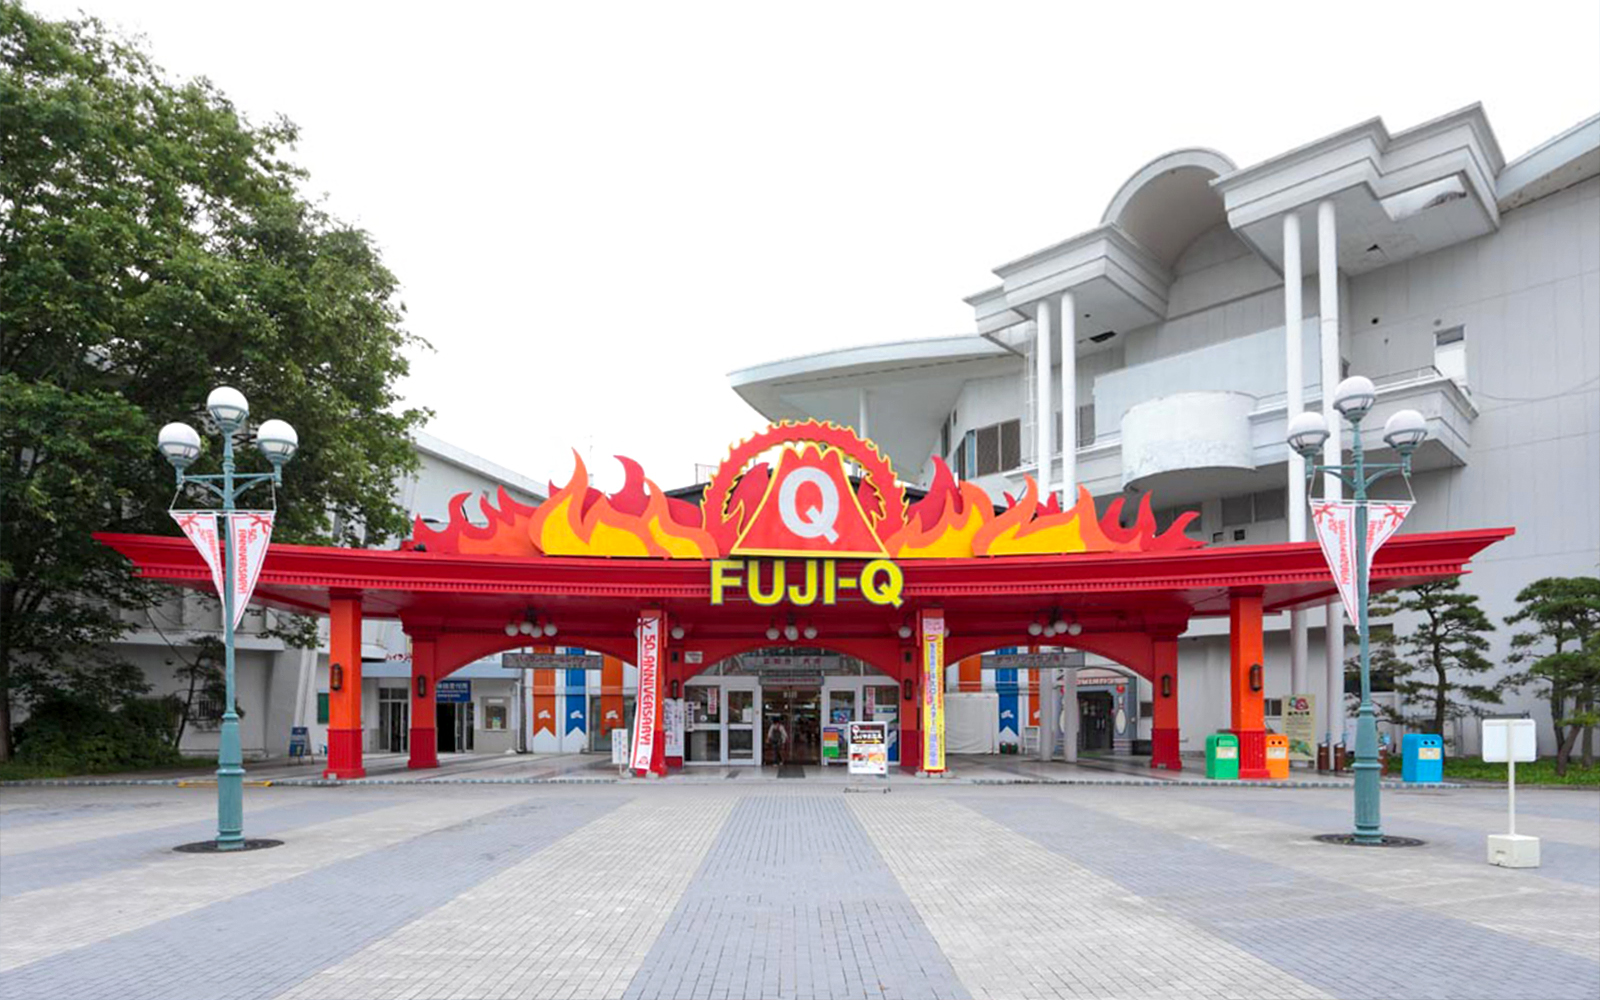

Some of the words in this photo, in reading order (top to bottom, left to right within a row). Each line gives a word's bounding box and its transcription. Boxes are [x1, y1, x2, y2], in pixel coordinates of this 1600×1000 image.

[778, 466, 839, 544] Q
[710, 559, 904, 608] FUJI-Q
[641, 656, 656, 745] ANNIVERSARY!
